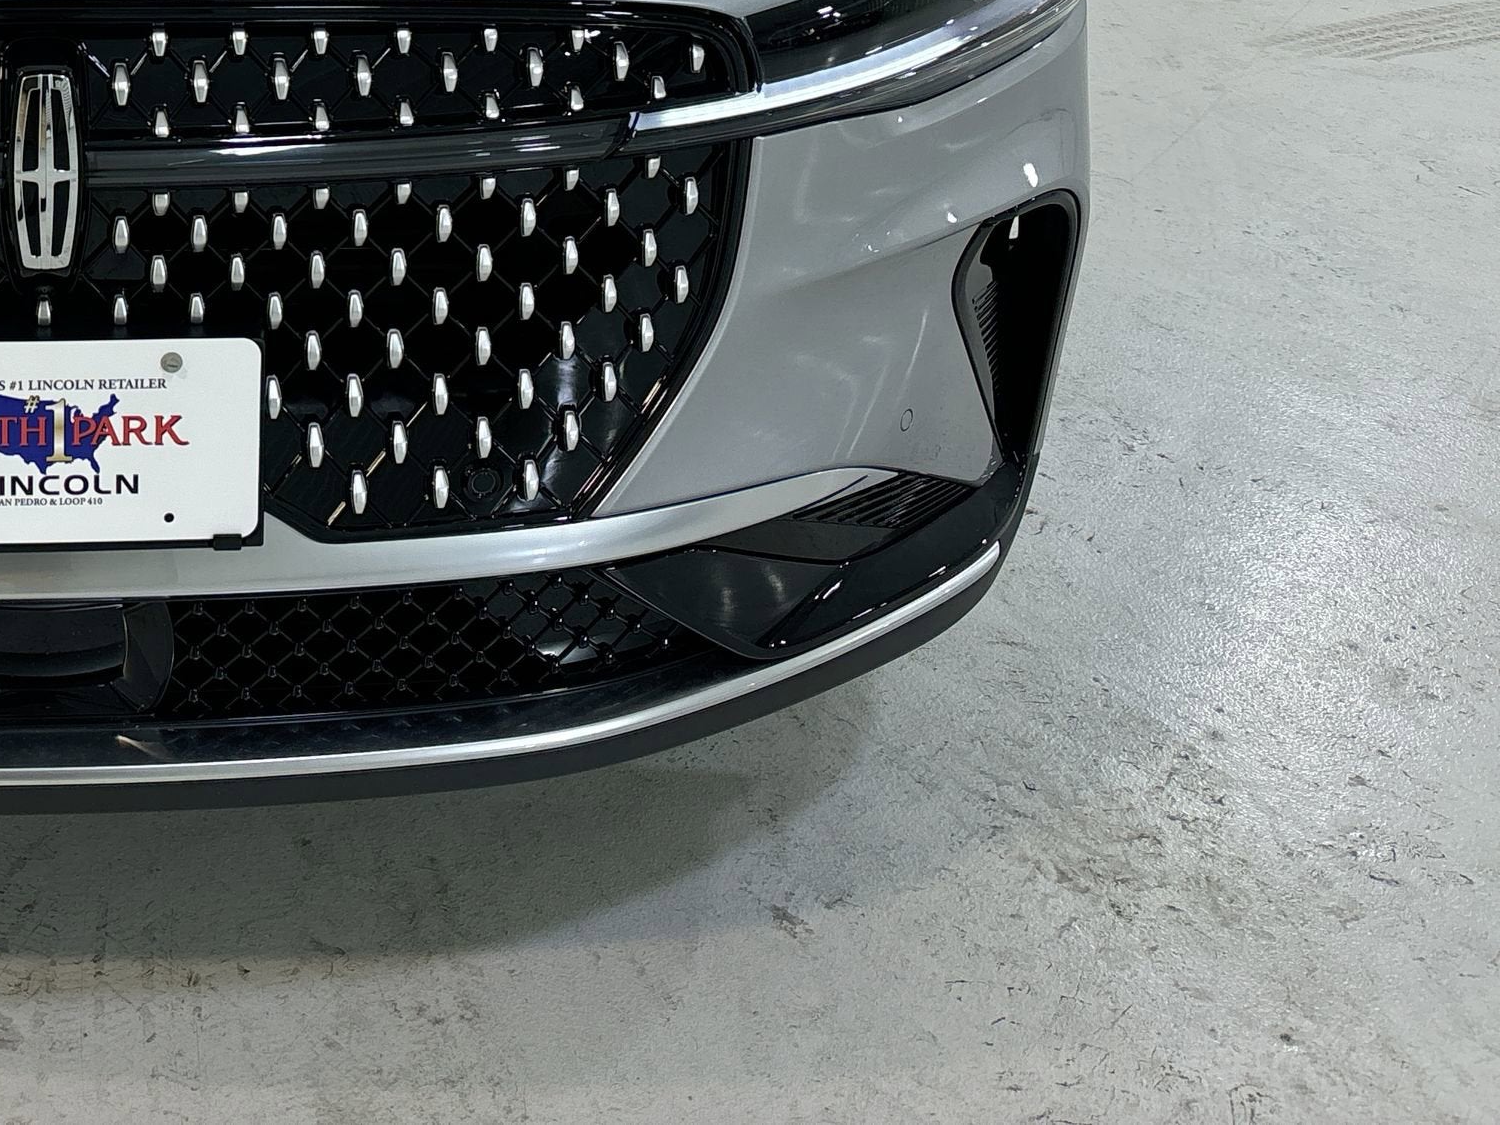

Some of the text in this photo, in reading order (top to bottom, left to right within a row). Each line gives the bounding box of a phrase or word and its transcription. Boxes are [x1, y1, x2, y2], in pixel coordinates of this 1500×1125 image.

[8, 379, 23, 392] #1
[27, 378, 95, 391] LINCOLN
[98, 378, 167, 390] RETAILER
[71, 414, 190, 447] PARK
[14, 497, 47, 506] PEDRO
[49, 497, 57, 506] &
[59, 497, 86, 506] LOOP
[87, 497, 103, 506] 410
